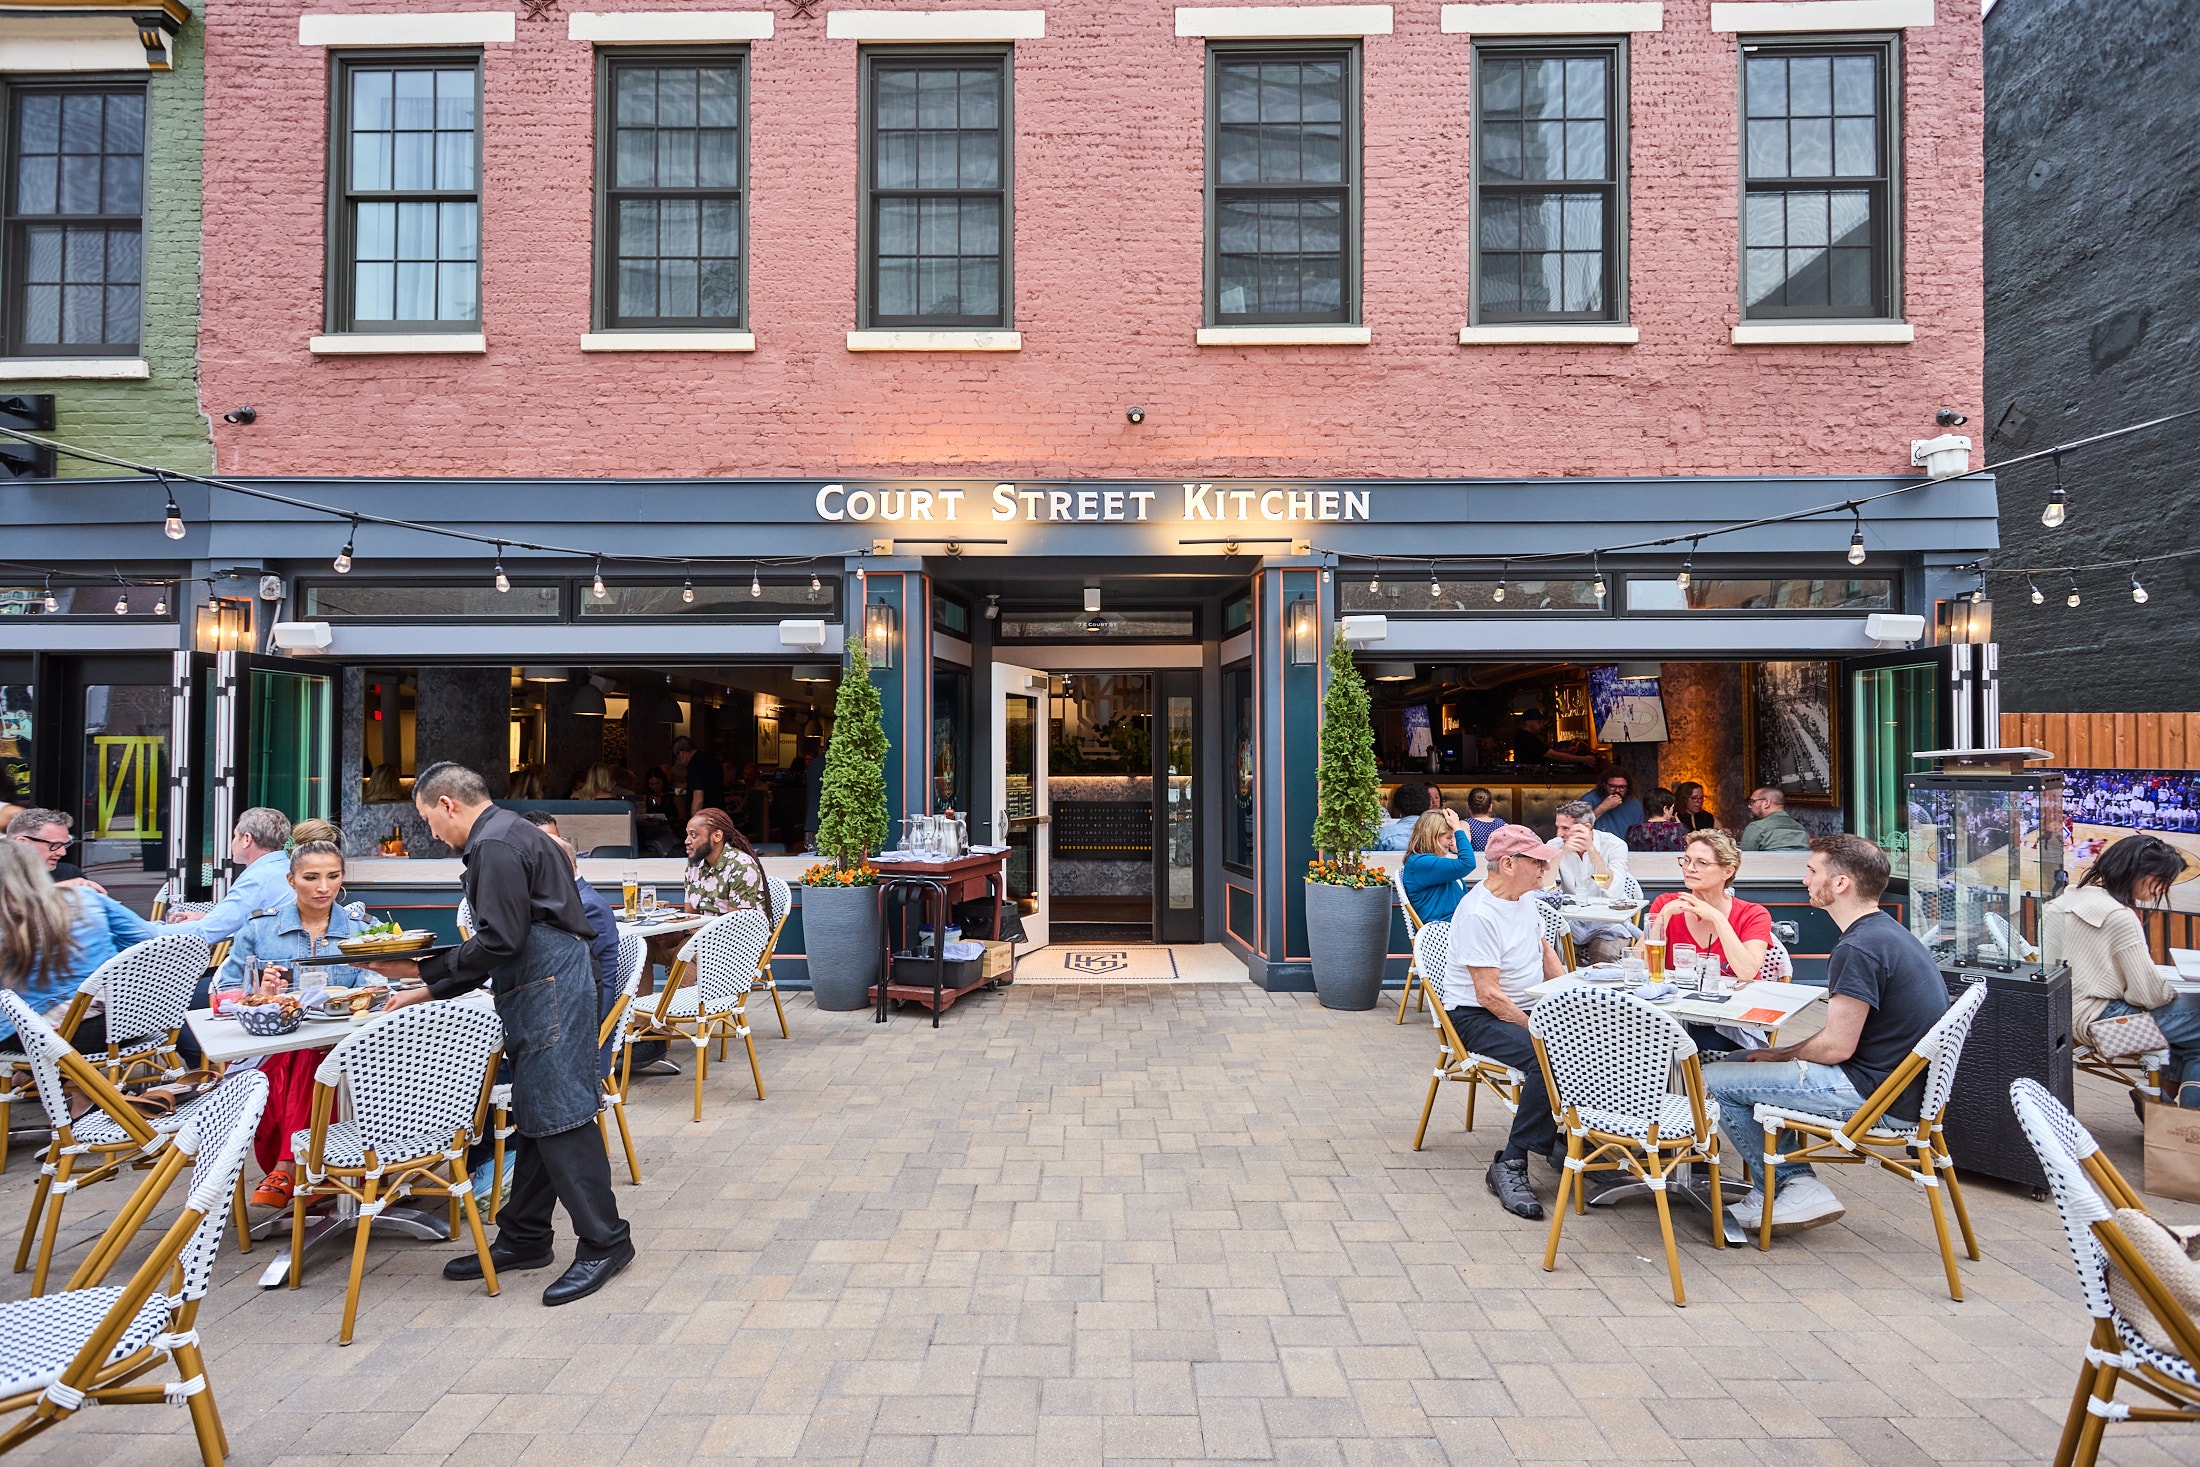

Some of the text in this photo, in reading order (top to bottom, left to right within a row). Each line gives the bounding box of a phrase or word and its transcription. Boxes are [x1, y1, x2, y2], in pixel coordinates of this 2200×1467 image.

[815, 484, 1371, 521] COURT STREET KITCHEN
